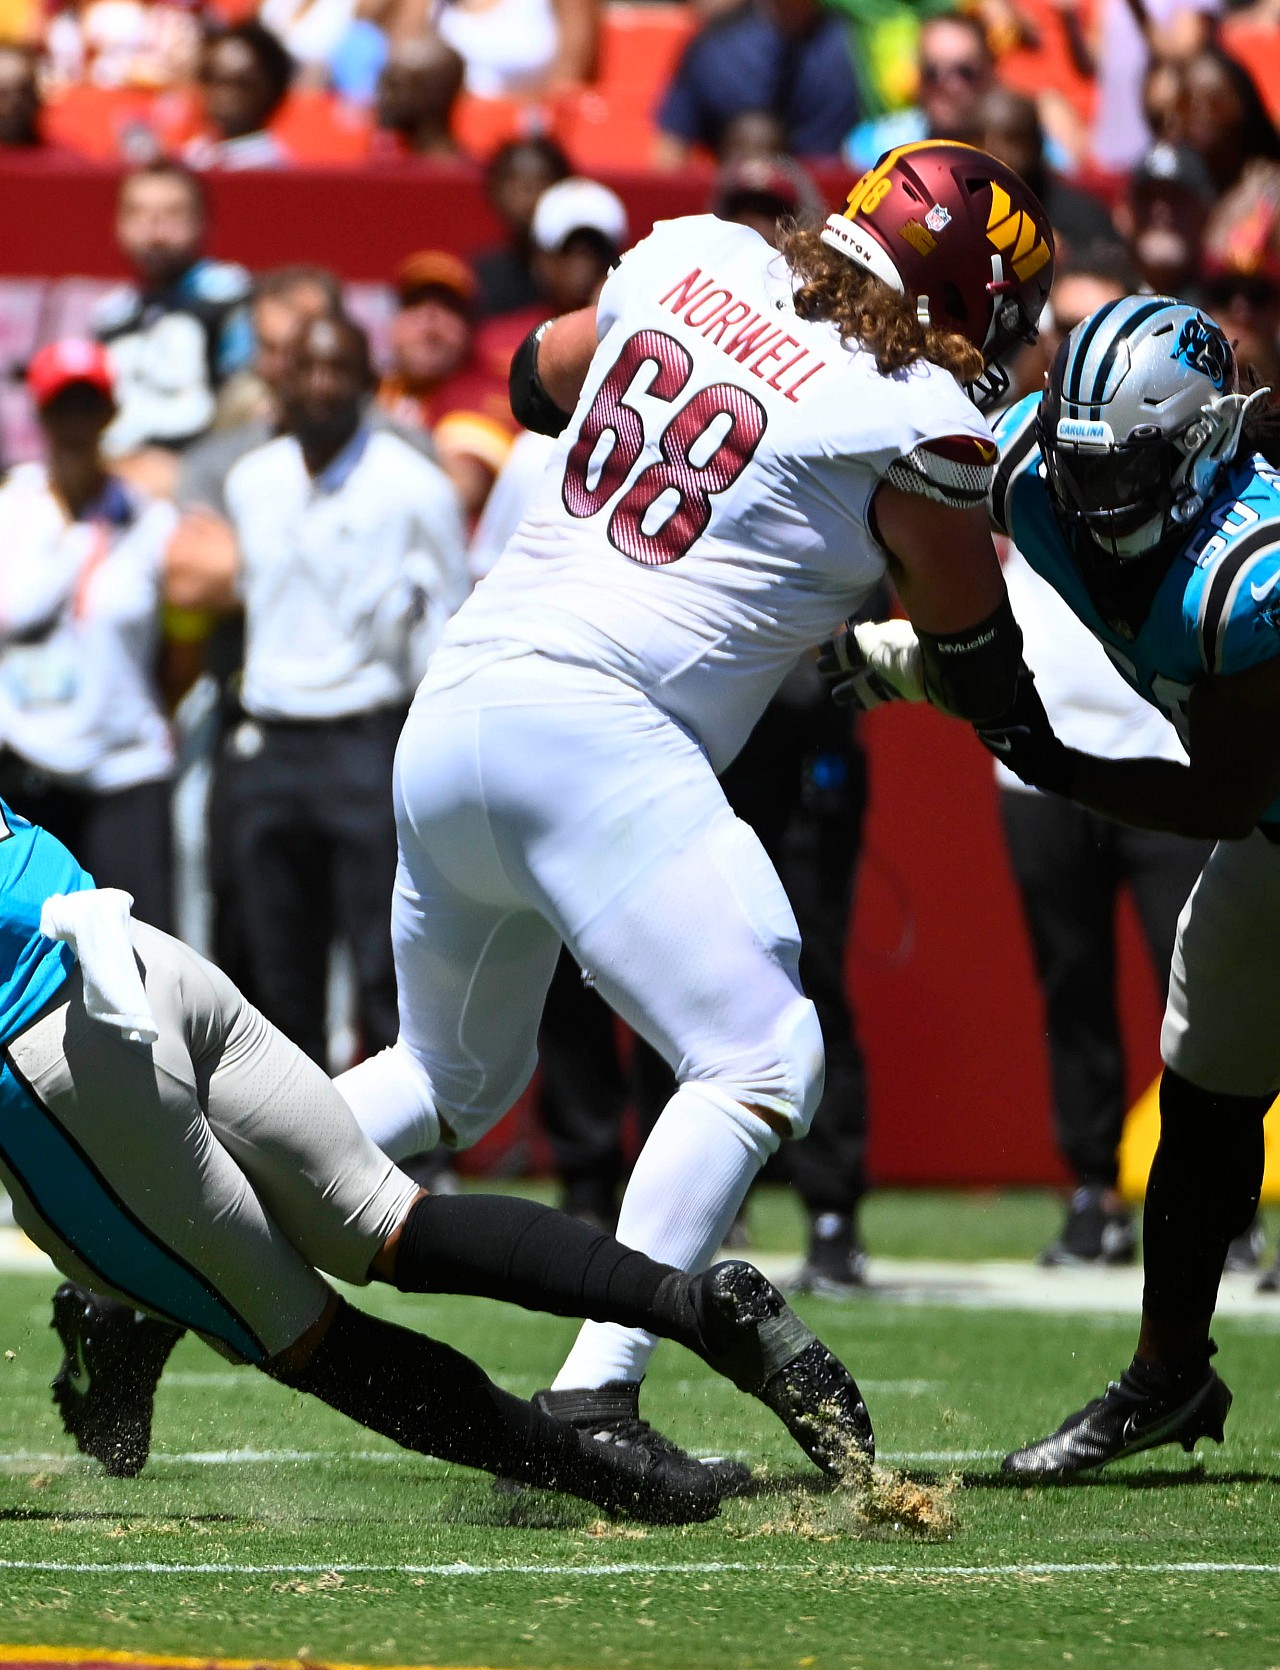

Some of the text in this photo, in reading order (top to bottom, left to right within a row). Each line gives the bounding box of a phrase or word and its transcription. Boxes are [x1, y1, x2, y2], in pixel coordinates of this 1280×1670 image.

[659, 268, 825, 403] NORWELL
[562, 329, 768, 566] 68
[1060, 423, 1105, 437] CAROLINA
[1184, 500, 1261, 570] 50
